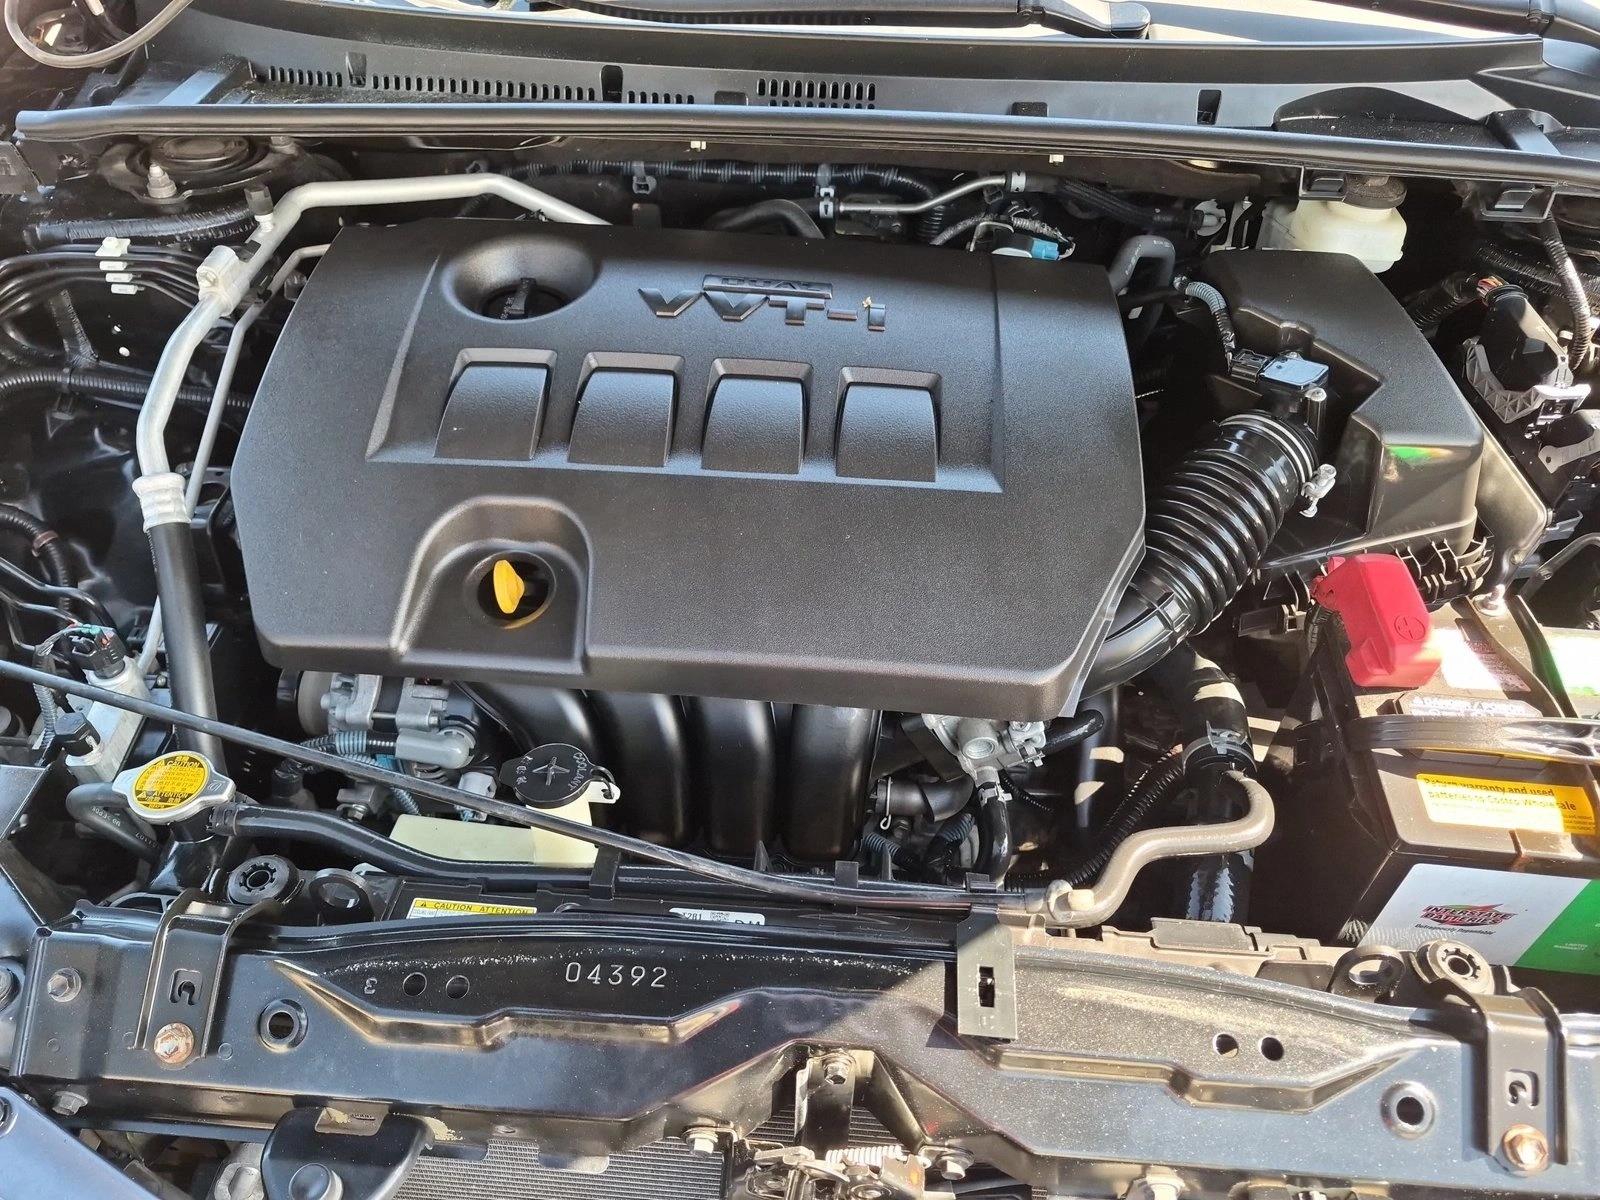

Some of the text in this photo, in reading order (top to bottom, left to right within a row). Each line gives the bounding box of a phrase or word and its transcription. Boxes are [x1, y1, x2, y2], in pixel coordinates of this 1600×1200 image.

[166, 760, 201, 768] CAUTION
[1459, 783, 1506, 795] warranty
[1508, 786, 1528, 795] and
[1530, 787, 1556, 797] used
[433, 902, 473, 911] CAUTION
[479, 906, 529, 915] ATTENTION
[1423, 904, 1515, 920] INTERSTATE
[1420, 911, 1504, 925] BATTERIES
[565, 961, 667, 988] 04392
